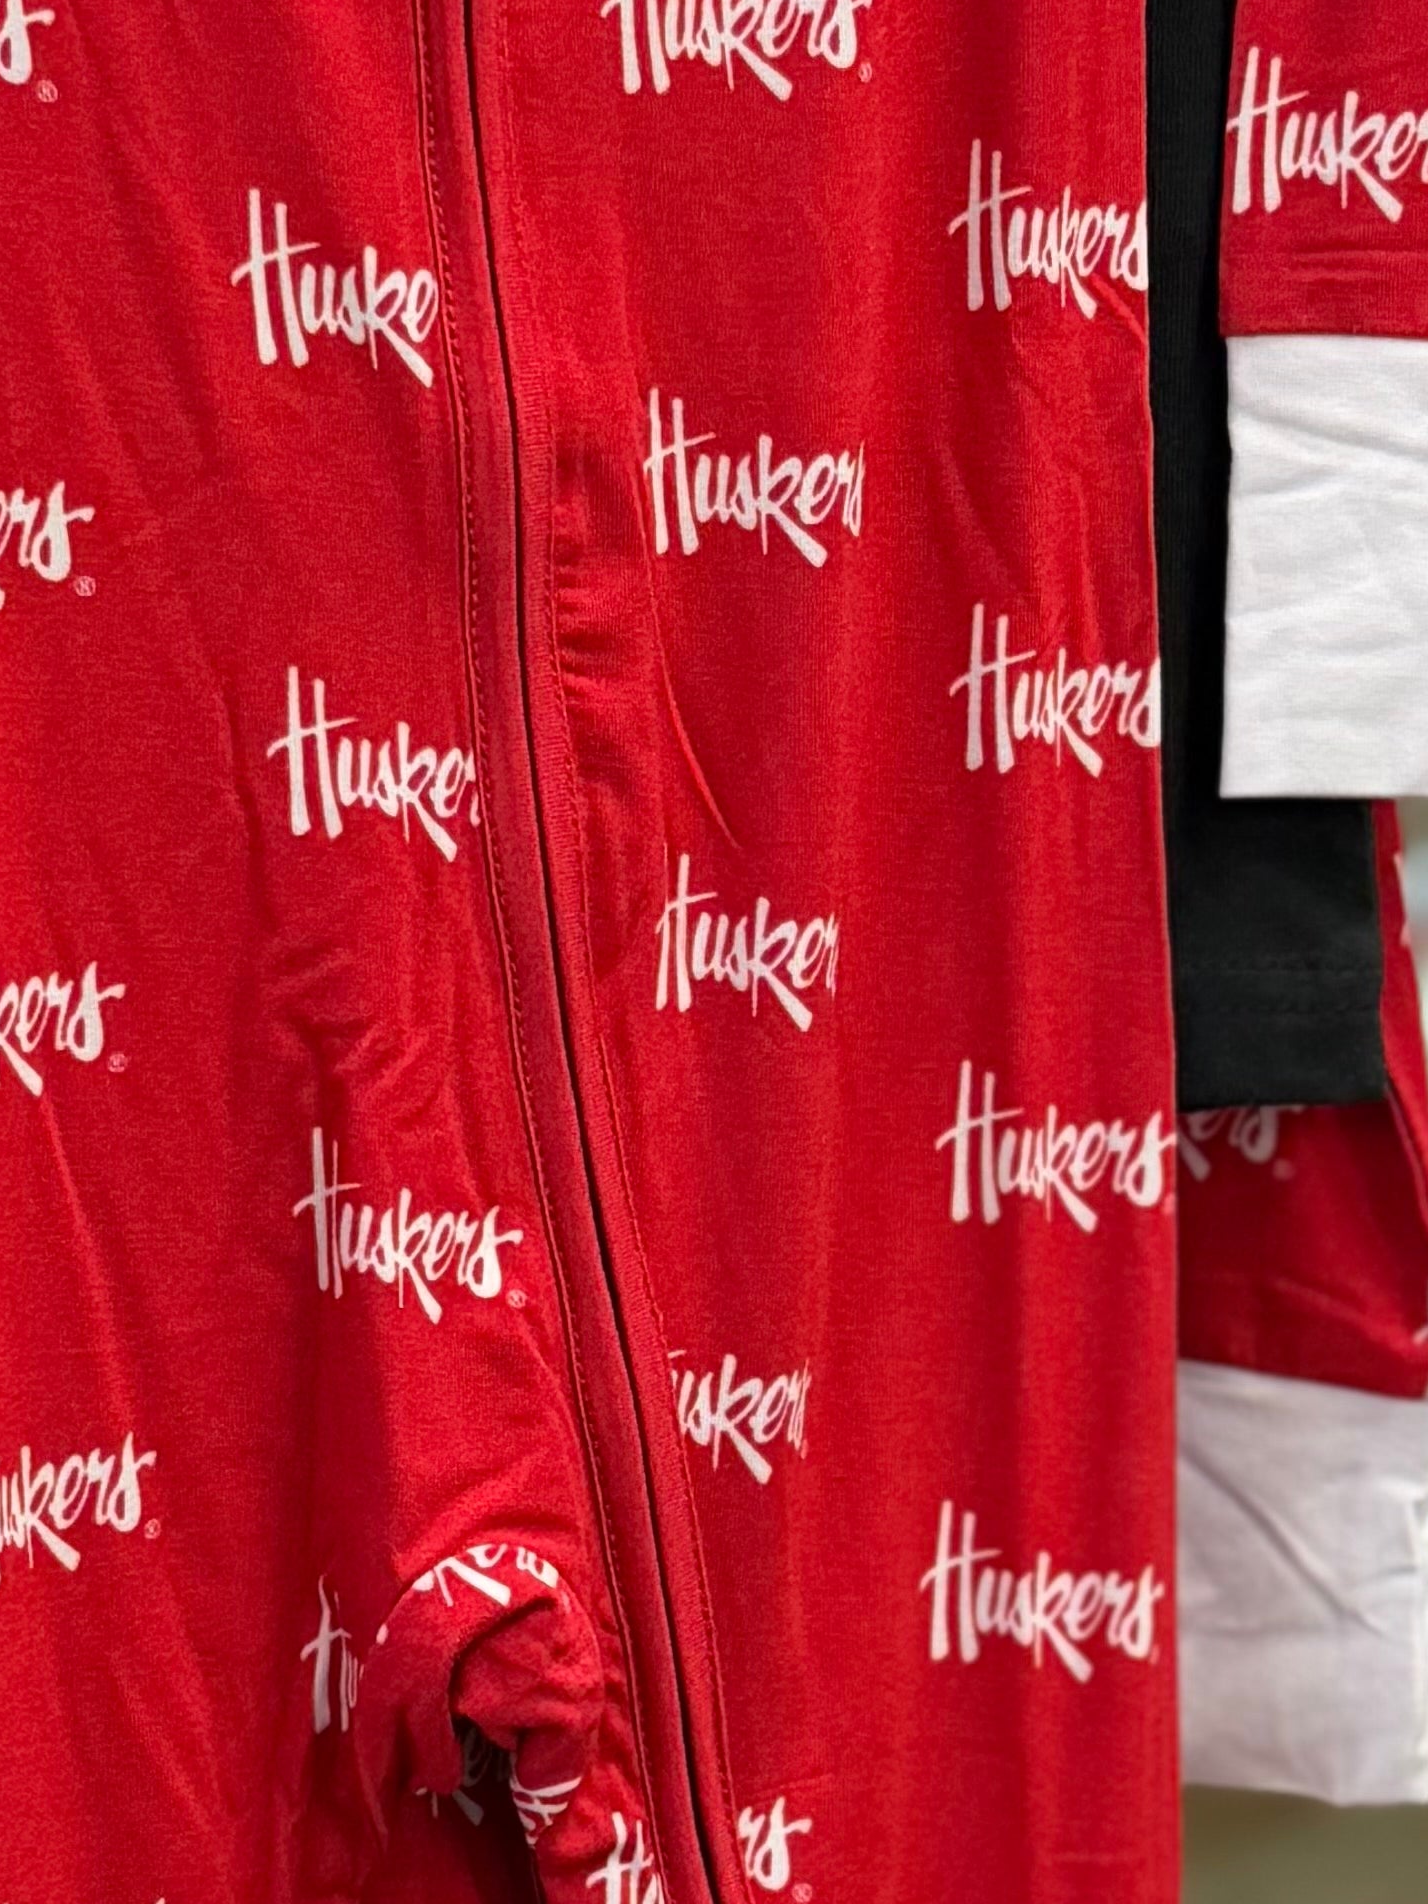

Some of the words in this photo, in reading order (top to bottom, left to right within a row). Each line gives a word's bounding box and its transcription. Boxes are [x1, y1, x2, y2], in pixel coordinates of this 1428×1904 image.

[229, 186, 440, 390] Huske
[292, 1125, 527, 1326] Huskers
[934, 1058, 1181, 1234] Huskers
[918, 1499, 1166, 1684] Huskers
